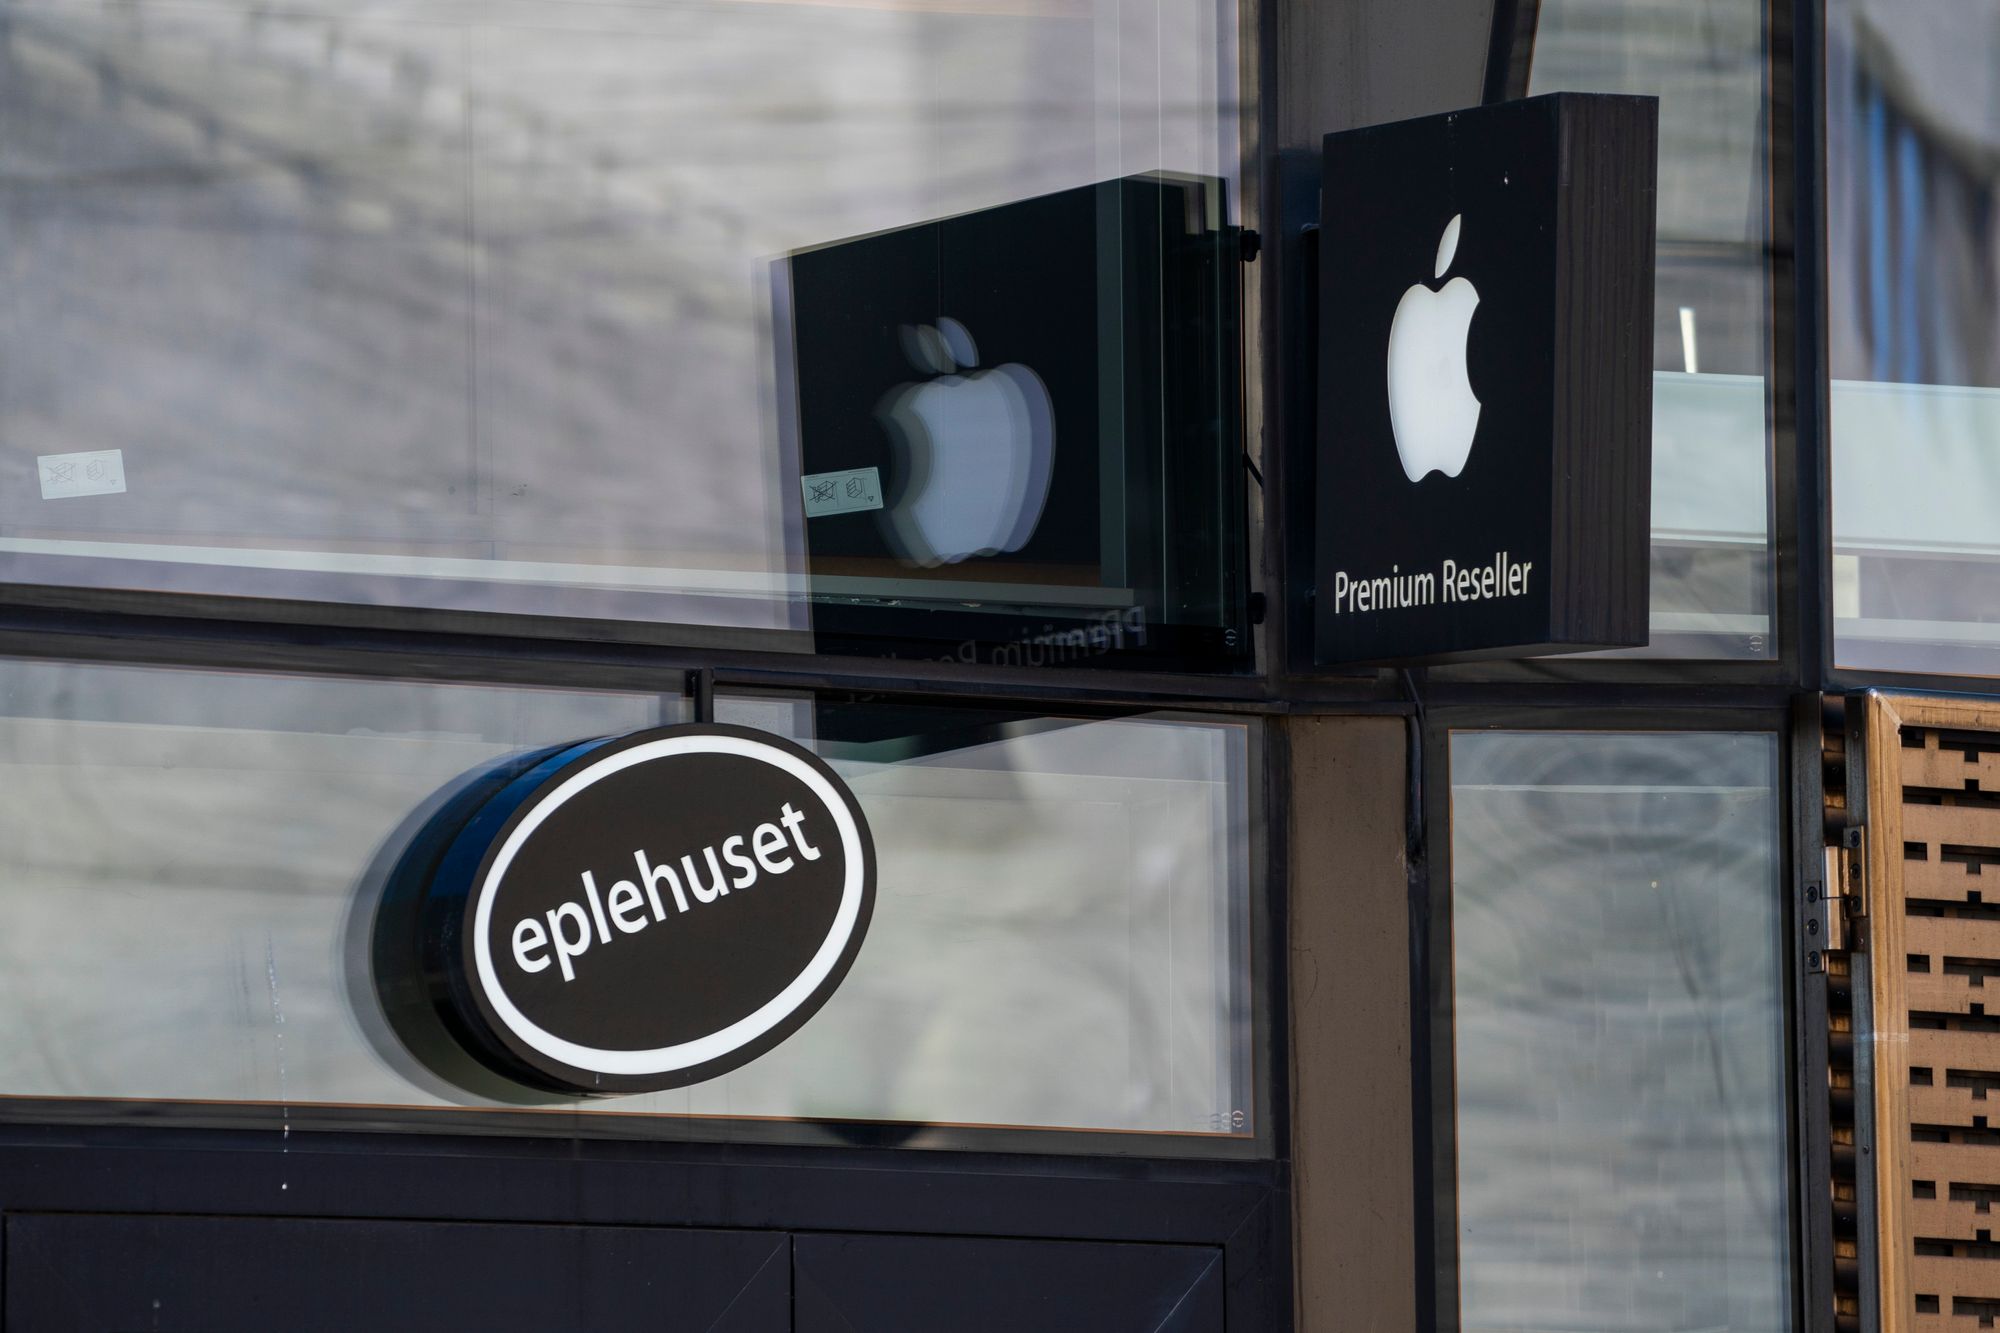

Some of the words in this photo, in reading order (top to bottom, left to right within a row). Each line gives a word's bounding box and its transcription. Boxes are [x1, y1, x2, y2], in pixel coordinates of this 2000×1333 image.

[1335, 564, 1435, 614] Premium
[1442, 551, 1532, 603] Reseller
[511, 801, 822, 983] eplehuset
